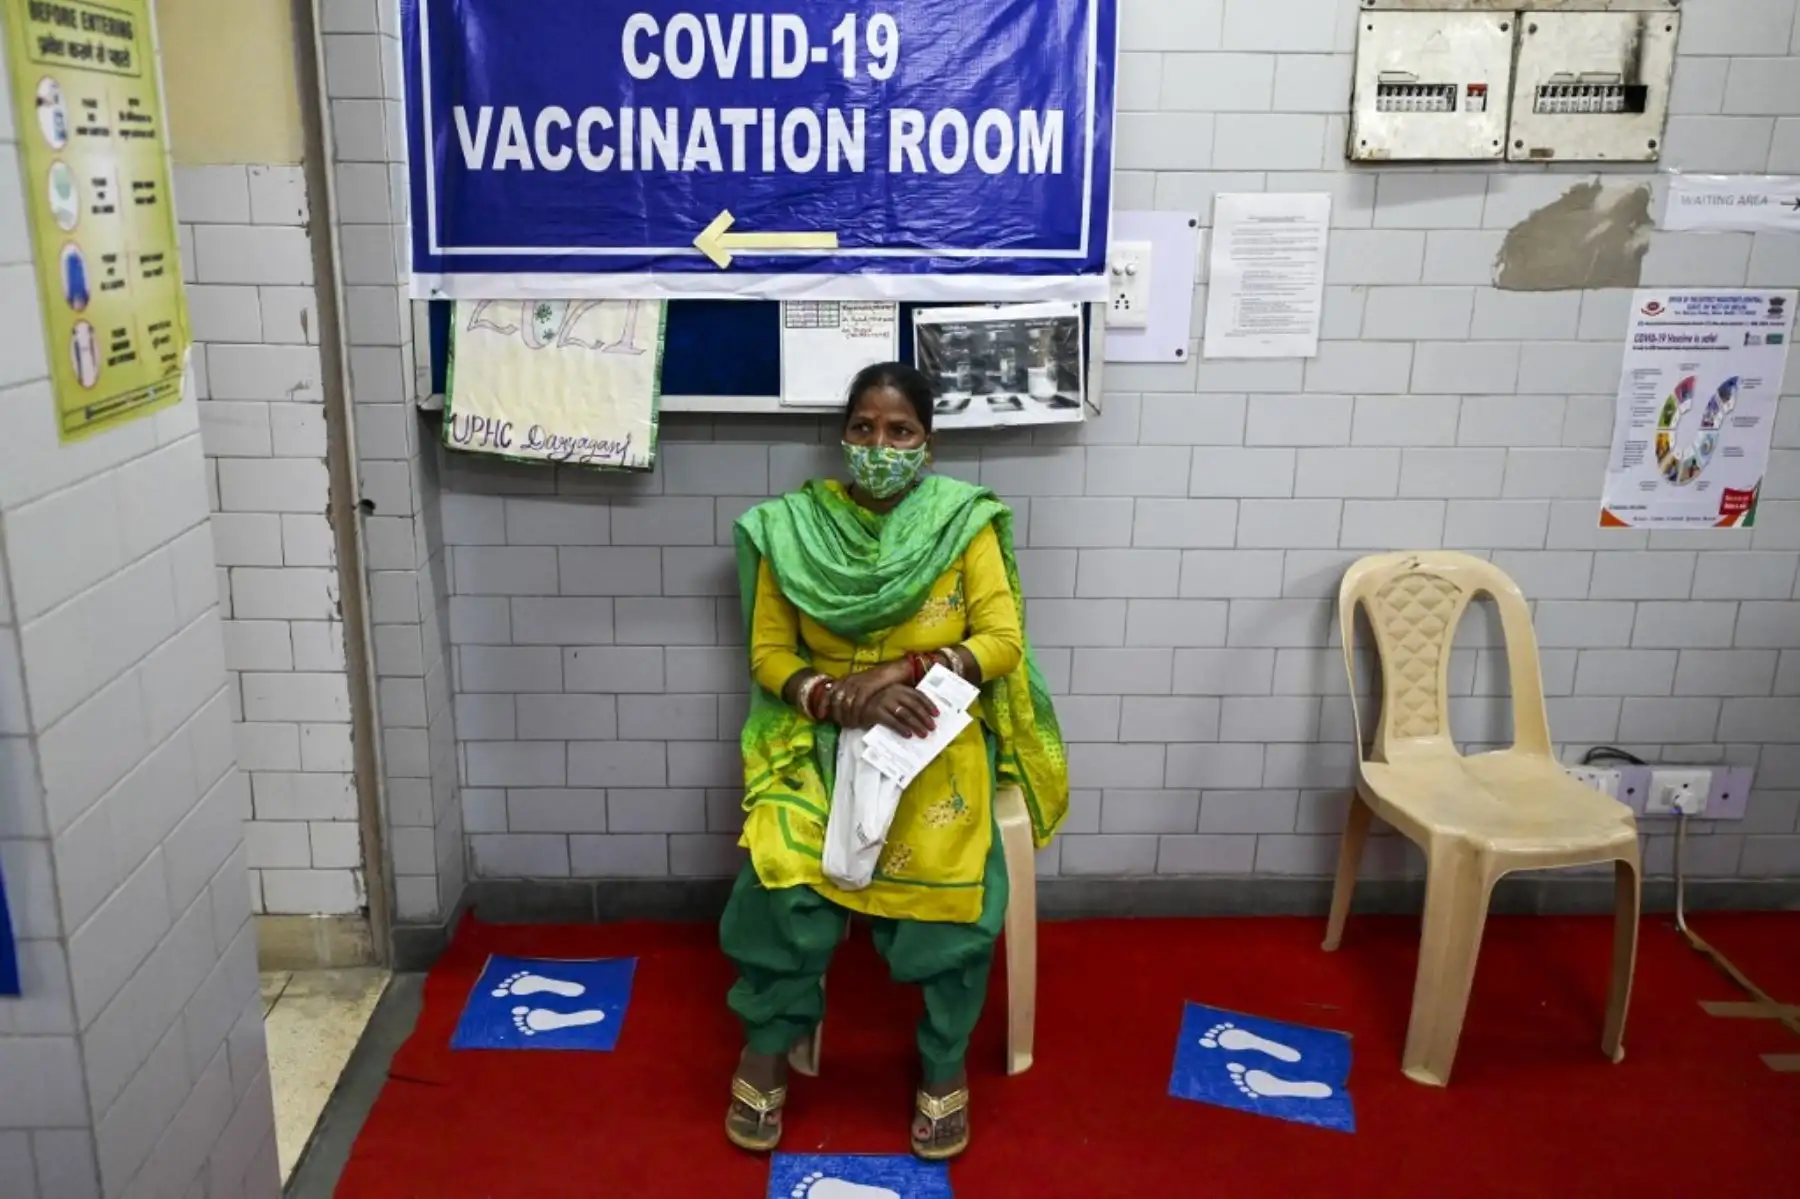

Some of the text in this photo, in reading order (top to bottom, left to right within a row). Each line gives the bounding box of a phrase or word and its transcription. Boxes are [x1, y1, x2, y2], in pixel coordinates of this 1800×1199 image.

[622, 12, 900, 81] COVID-19
[454, 105, 1063, 175] VACCINATION ROOM
[1680, 194, 1768, 206] WAITING AREA
[1634, 332, 1667, 344] COVID-19
[450, 411, 514, 449] UPHC
